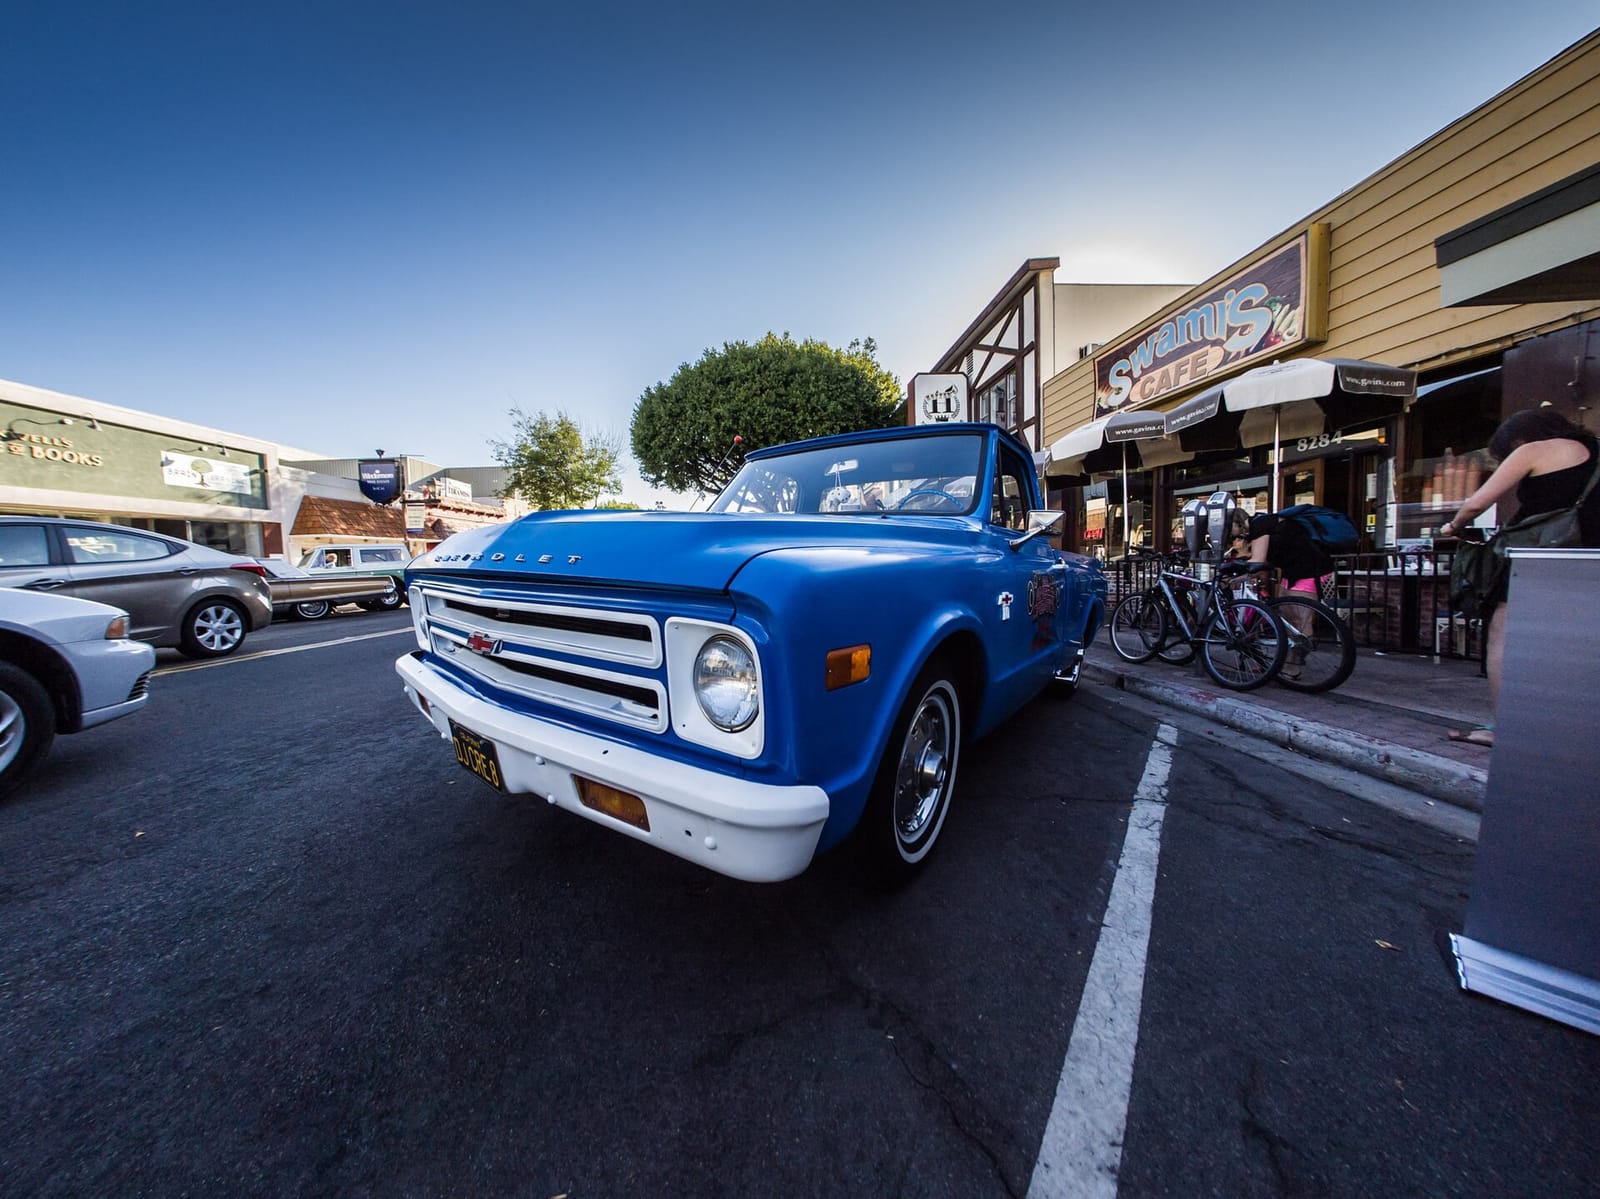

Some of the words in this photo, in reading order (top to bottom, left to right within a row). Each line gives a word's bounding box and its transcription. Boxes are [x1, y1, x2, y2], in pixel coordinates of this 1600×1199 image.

[1139, 350, 1209, 400] CAFE
[1115, 424, 1166, 435] www.gavina.c
[1297, 431, 1343, 451] 8284
[29, 445, 103, 467] BOOKS
